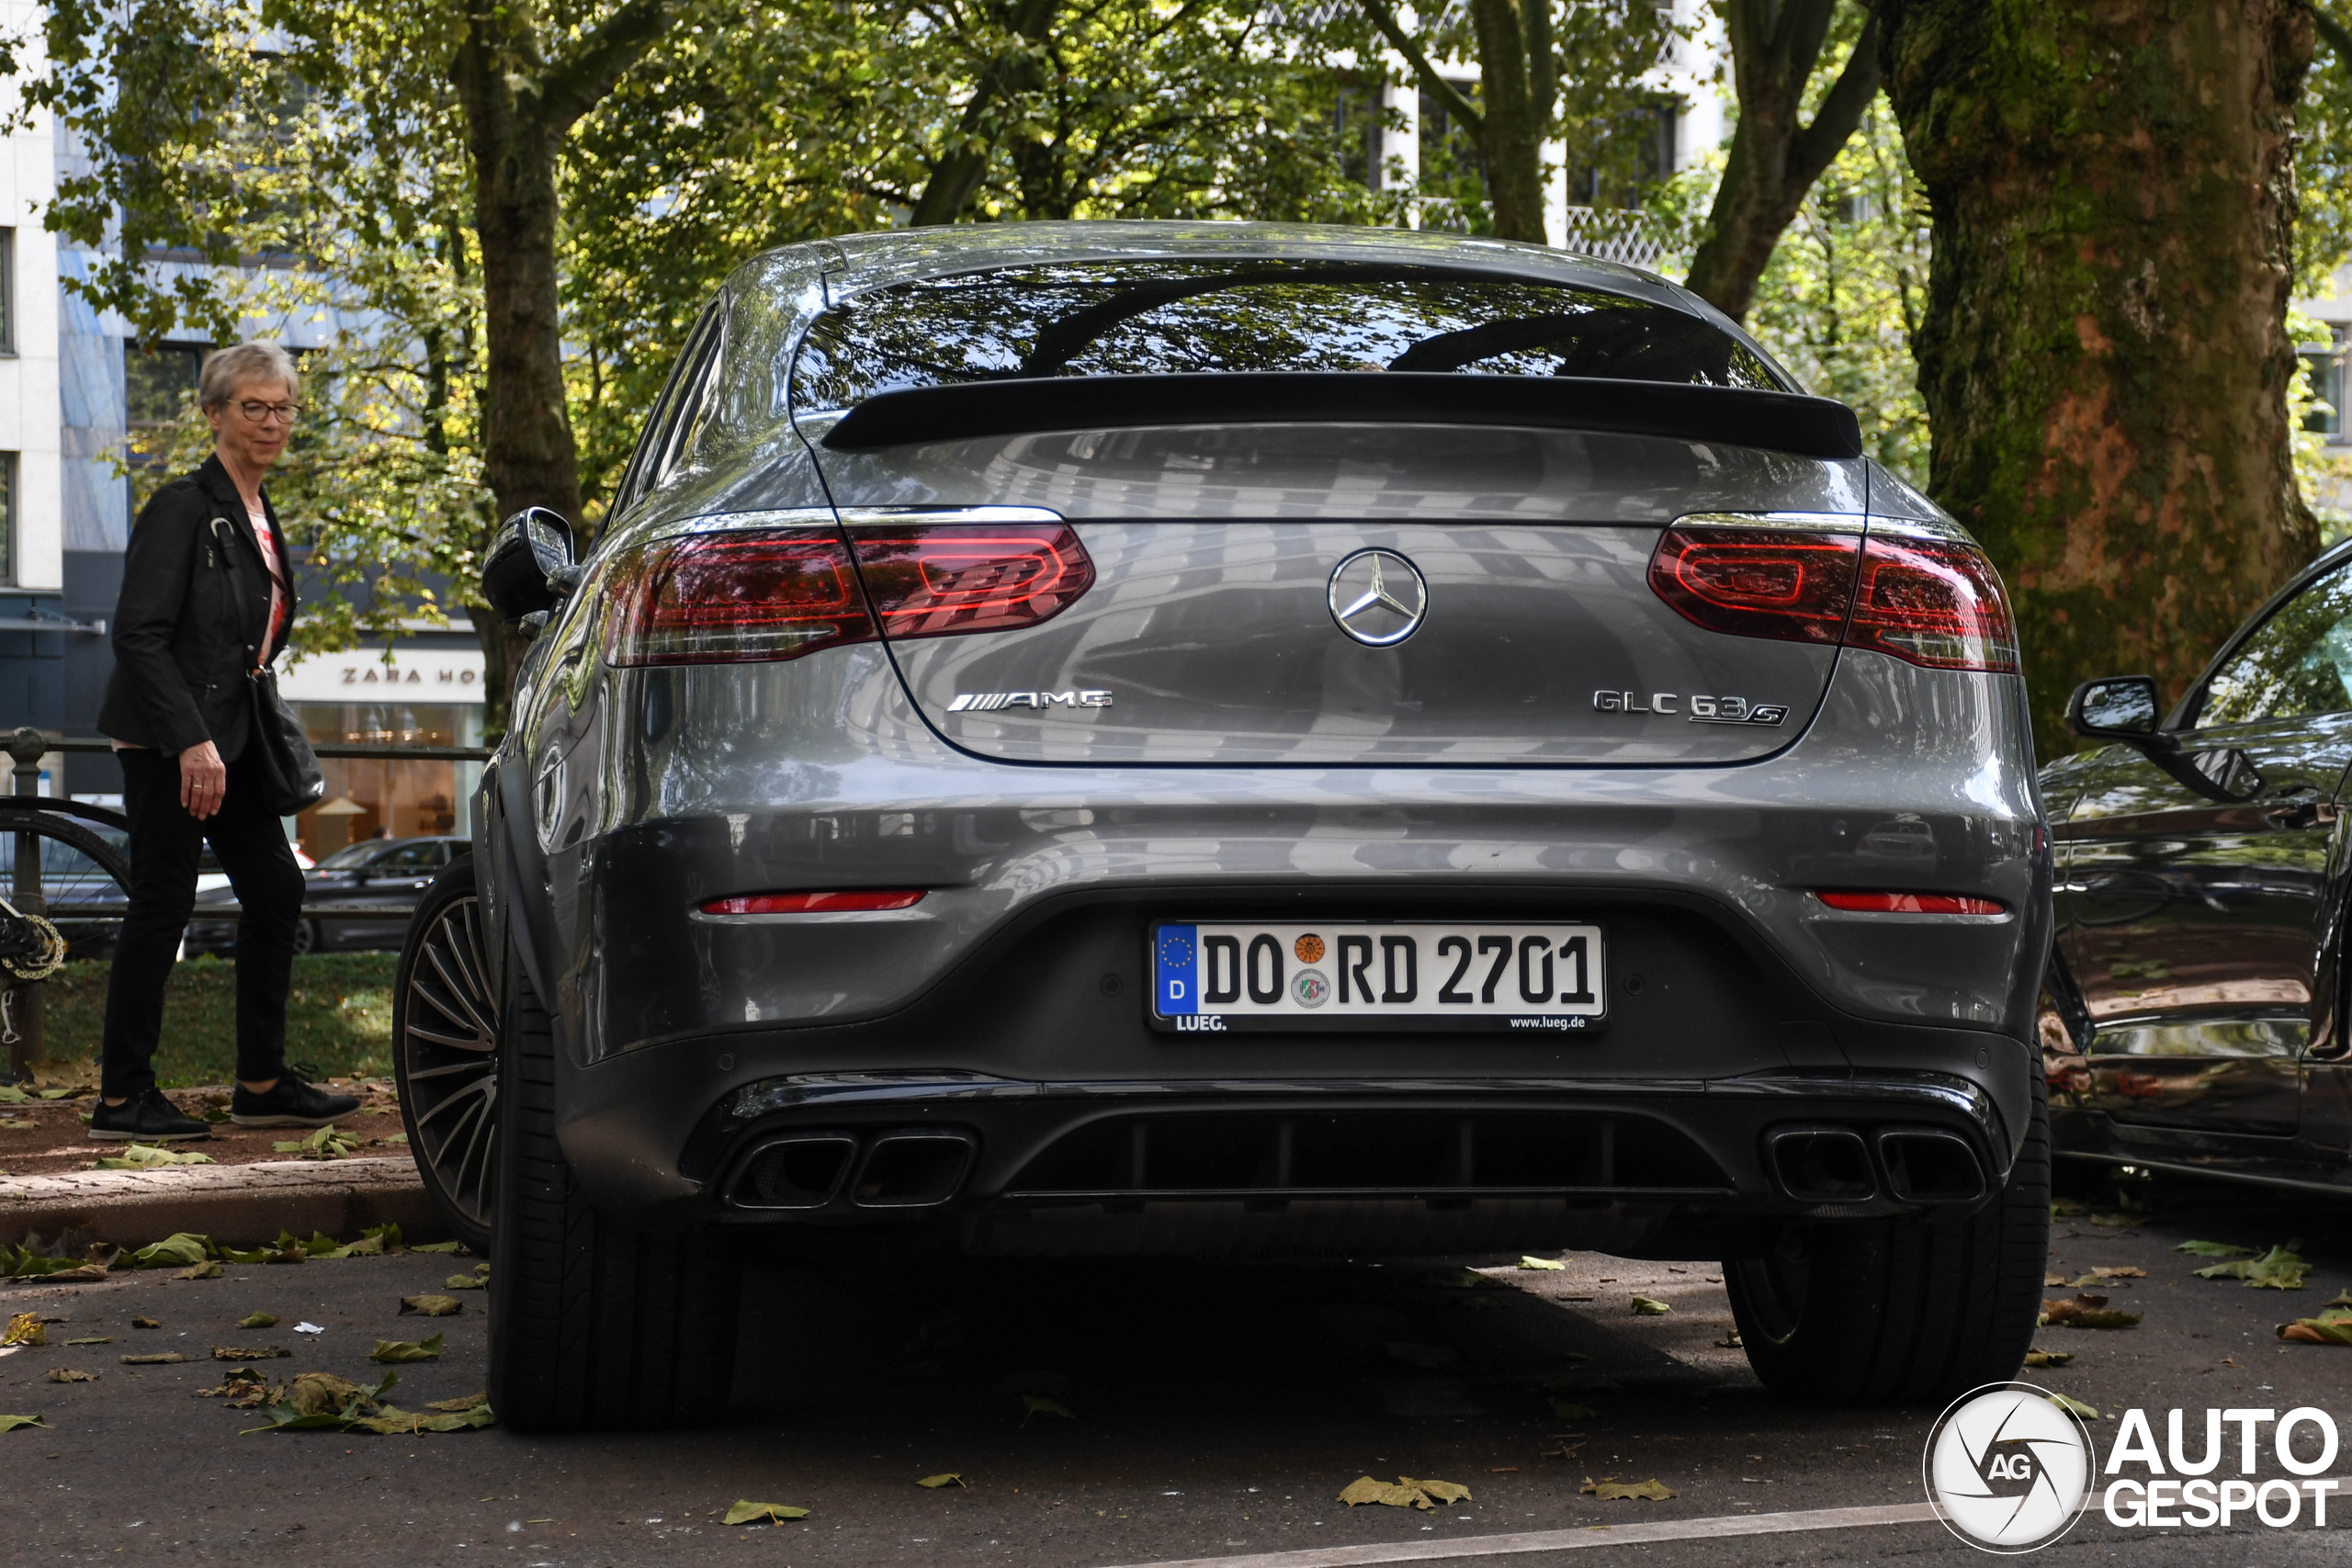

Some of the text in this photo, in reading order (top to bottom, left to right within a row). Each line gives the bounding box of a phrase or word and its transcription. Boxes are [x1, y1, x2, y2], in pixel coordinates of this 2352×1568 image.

[344, 669, 422, 682] ZARA
[1593, 690, 1678, 715] GLC
[1204, 933, 1284, 1004] DO
[1338, 935, 1418, 1003] RD
[1438, 935, 1595, 1003] 2701
[1170, 980, 1185, 999] D
[1177, 1016, 1227, 1032] LUEG.
[1510, 1016, 1586, 1031] www.lueg.de
